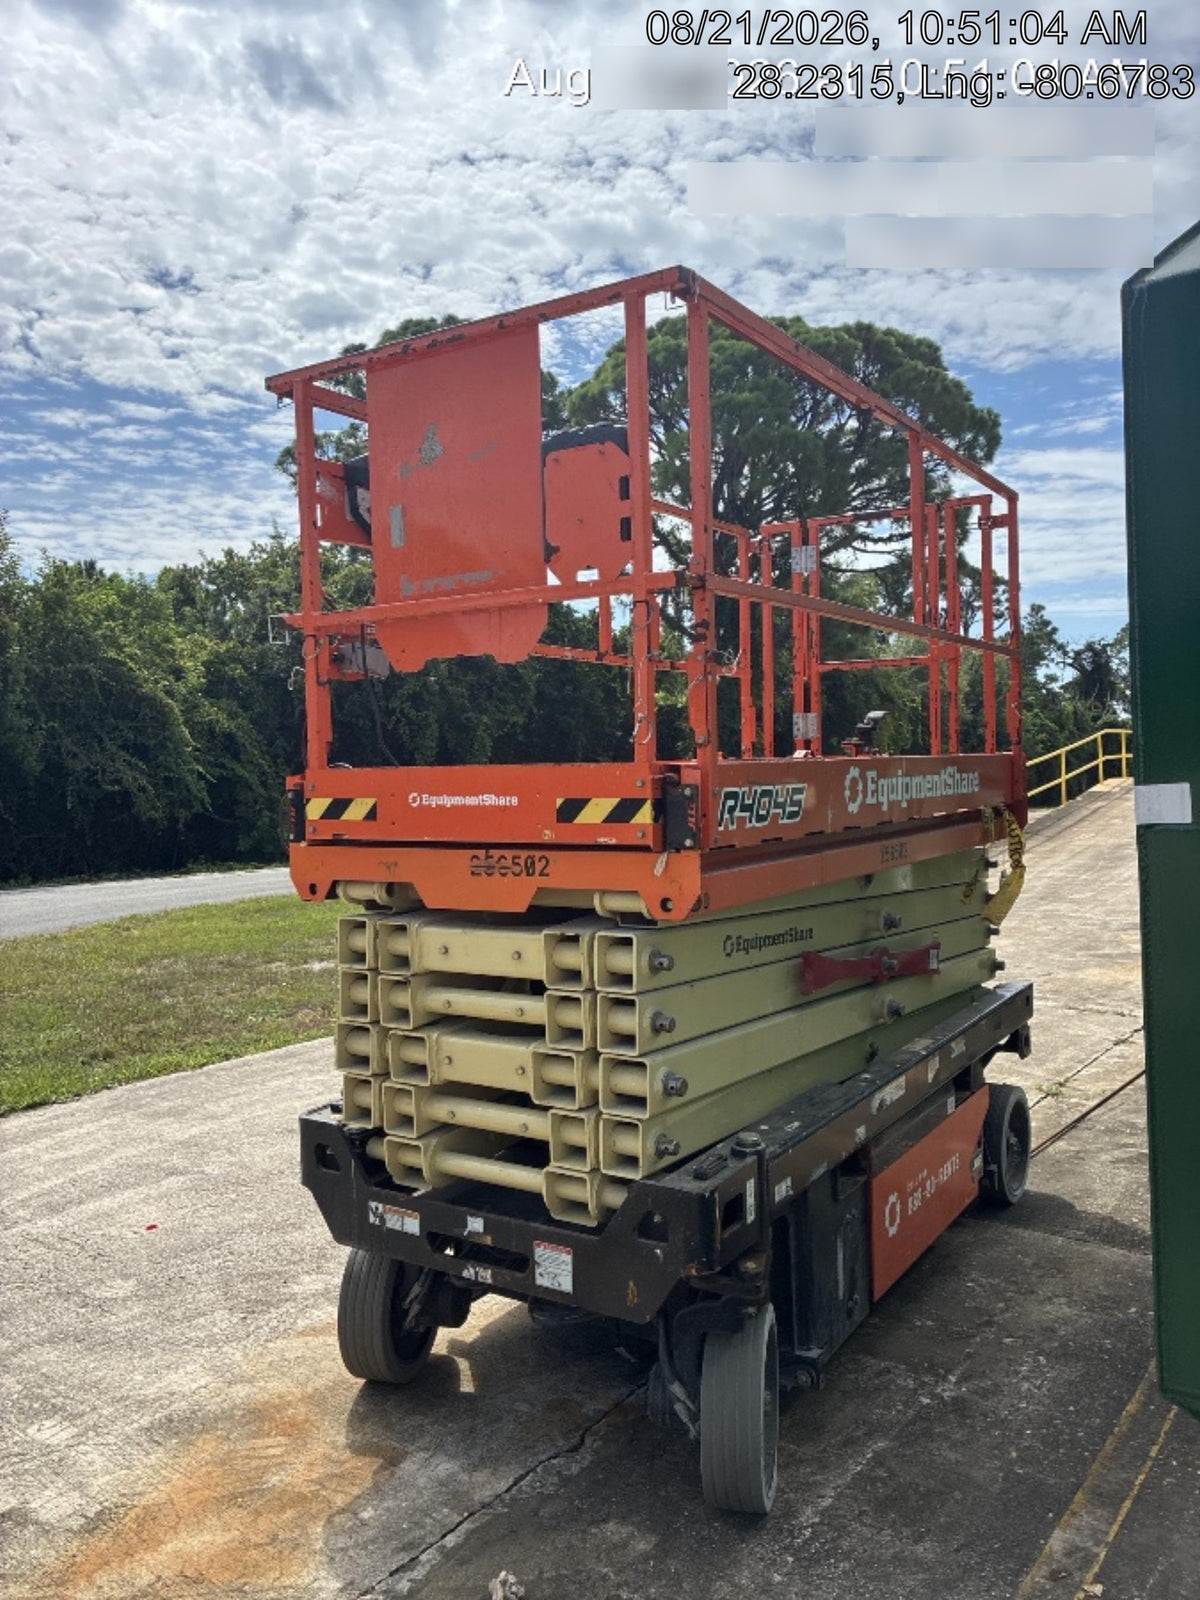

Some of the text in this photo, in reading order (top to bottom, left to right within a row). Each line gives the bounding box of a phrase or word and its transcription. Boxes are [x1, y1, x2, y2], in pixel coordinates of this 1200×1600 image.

[421, 793, 519, 808] EquipmentShare
[717, 783, 808, 831] R4045
[865, 766, 979, 811] EquipmentShare
[735, 926, 813, 955] EquipmentShare
